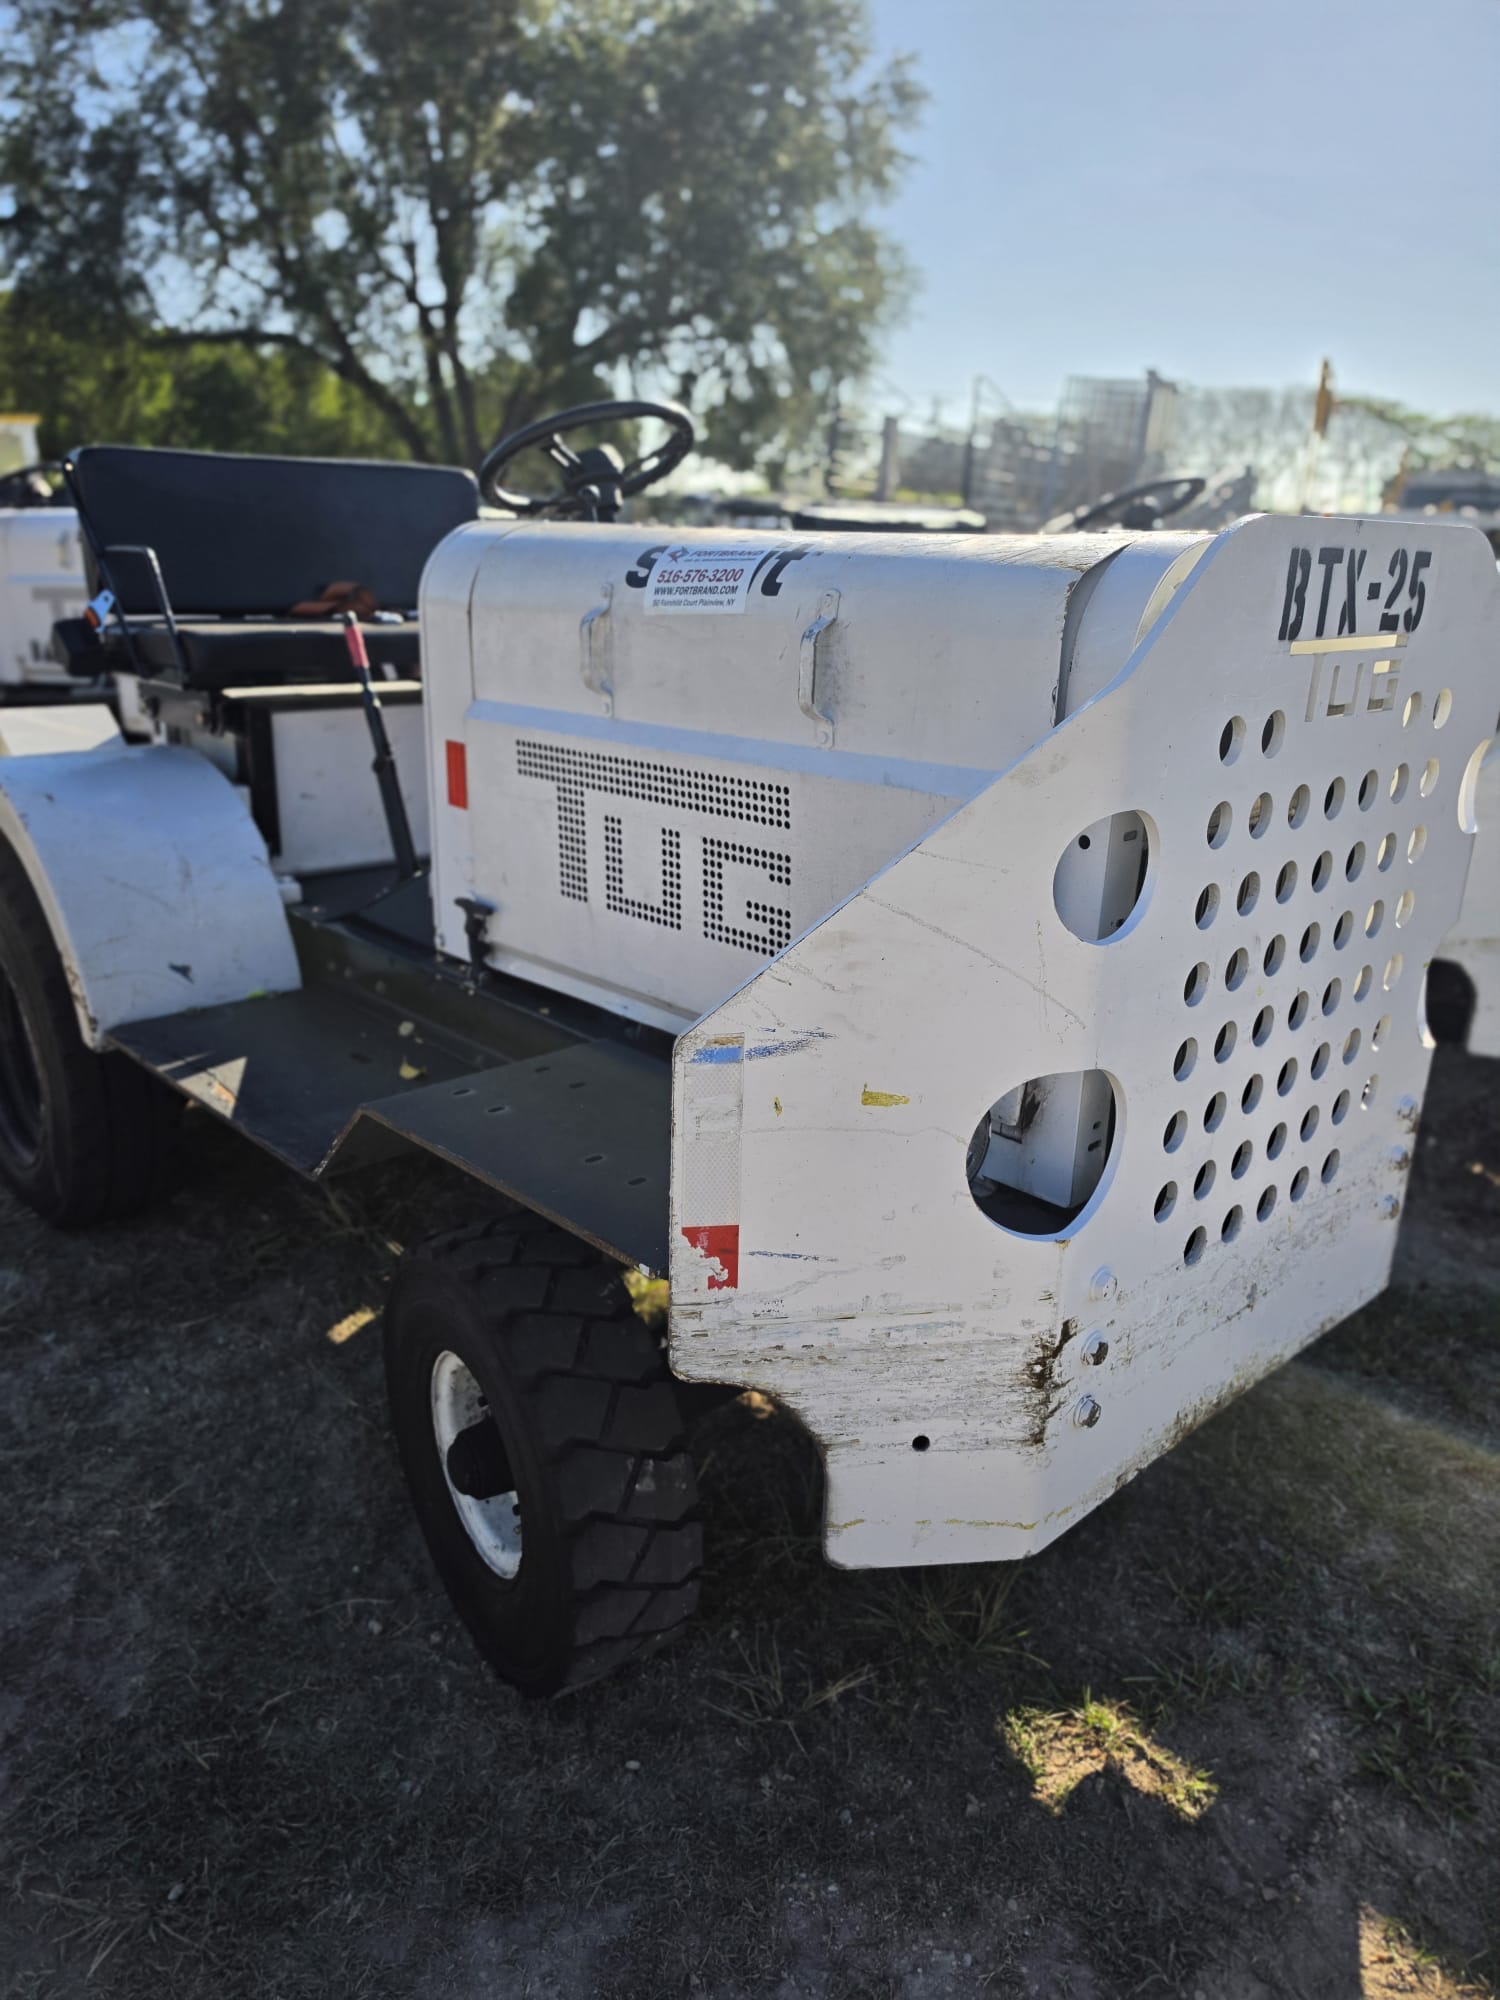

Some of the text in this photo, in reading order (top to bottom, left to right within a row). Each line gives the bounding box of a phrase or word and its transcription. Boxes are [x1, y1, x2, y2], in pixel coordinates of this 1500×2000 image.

[654, 586, 738, 595] WWW.FORTBRAND.COM
[657, 569, 744, 583] 516-576-3200
[1278, 547, 1432, 640] BTX-25
[683, 599, 697, 607] Court
[726, 598, 736, 606] NY
[1289, 634, 1409, 722] TUG
[516, 739, 791, 957] TUG
